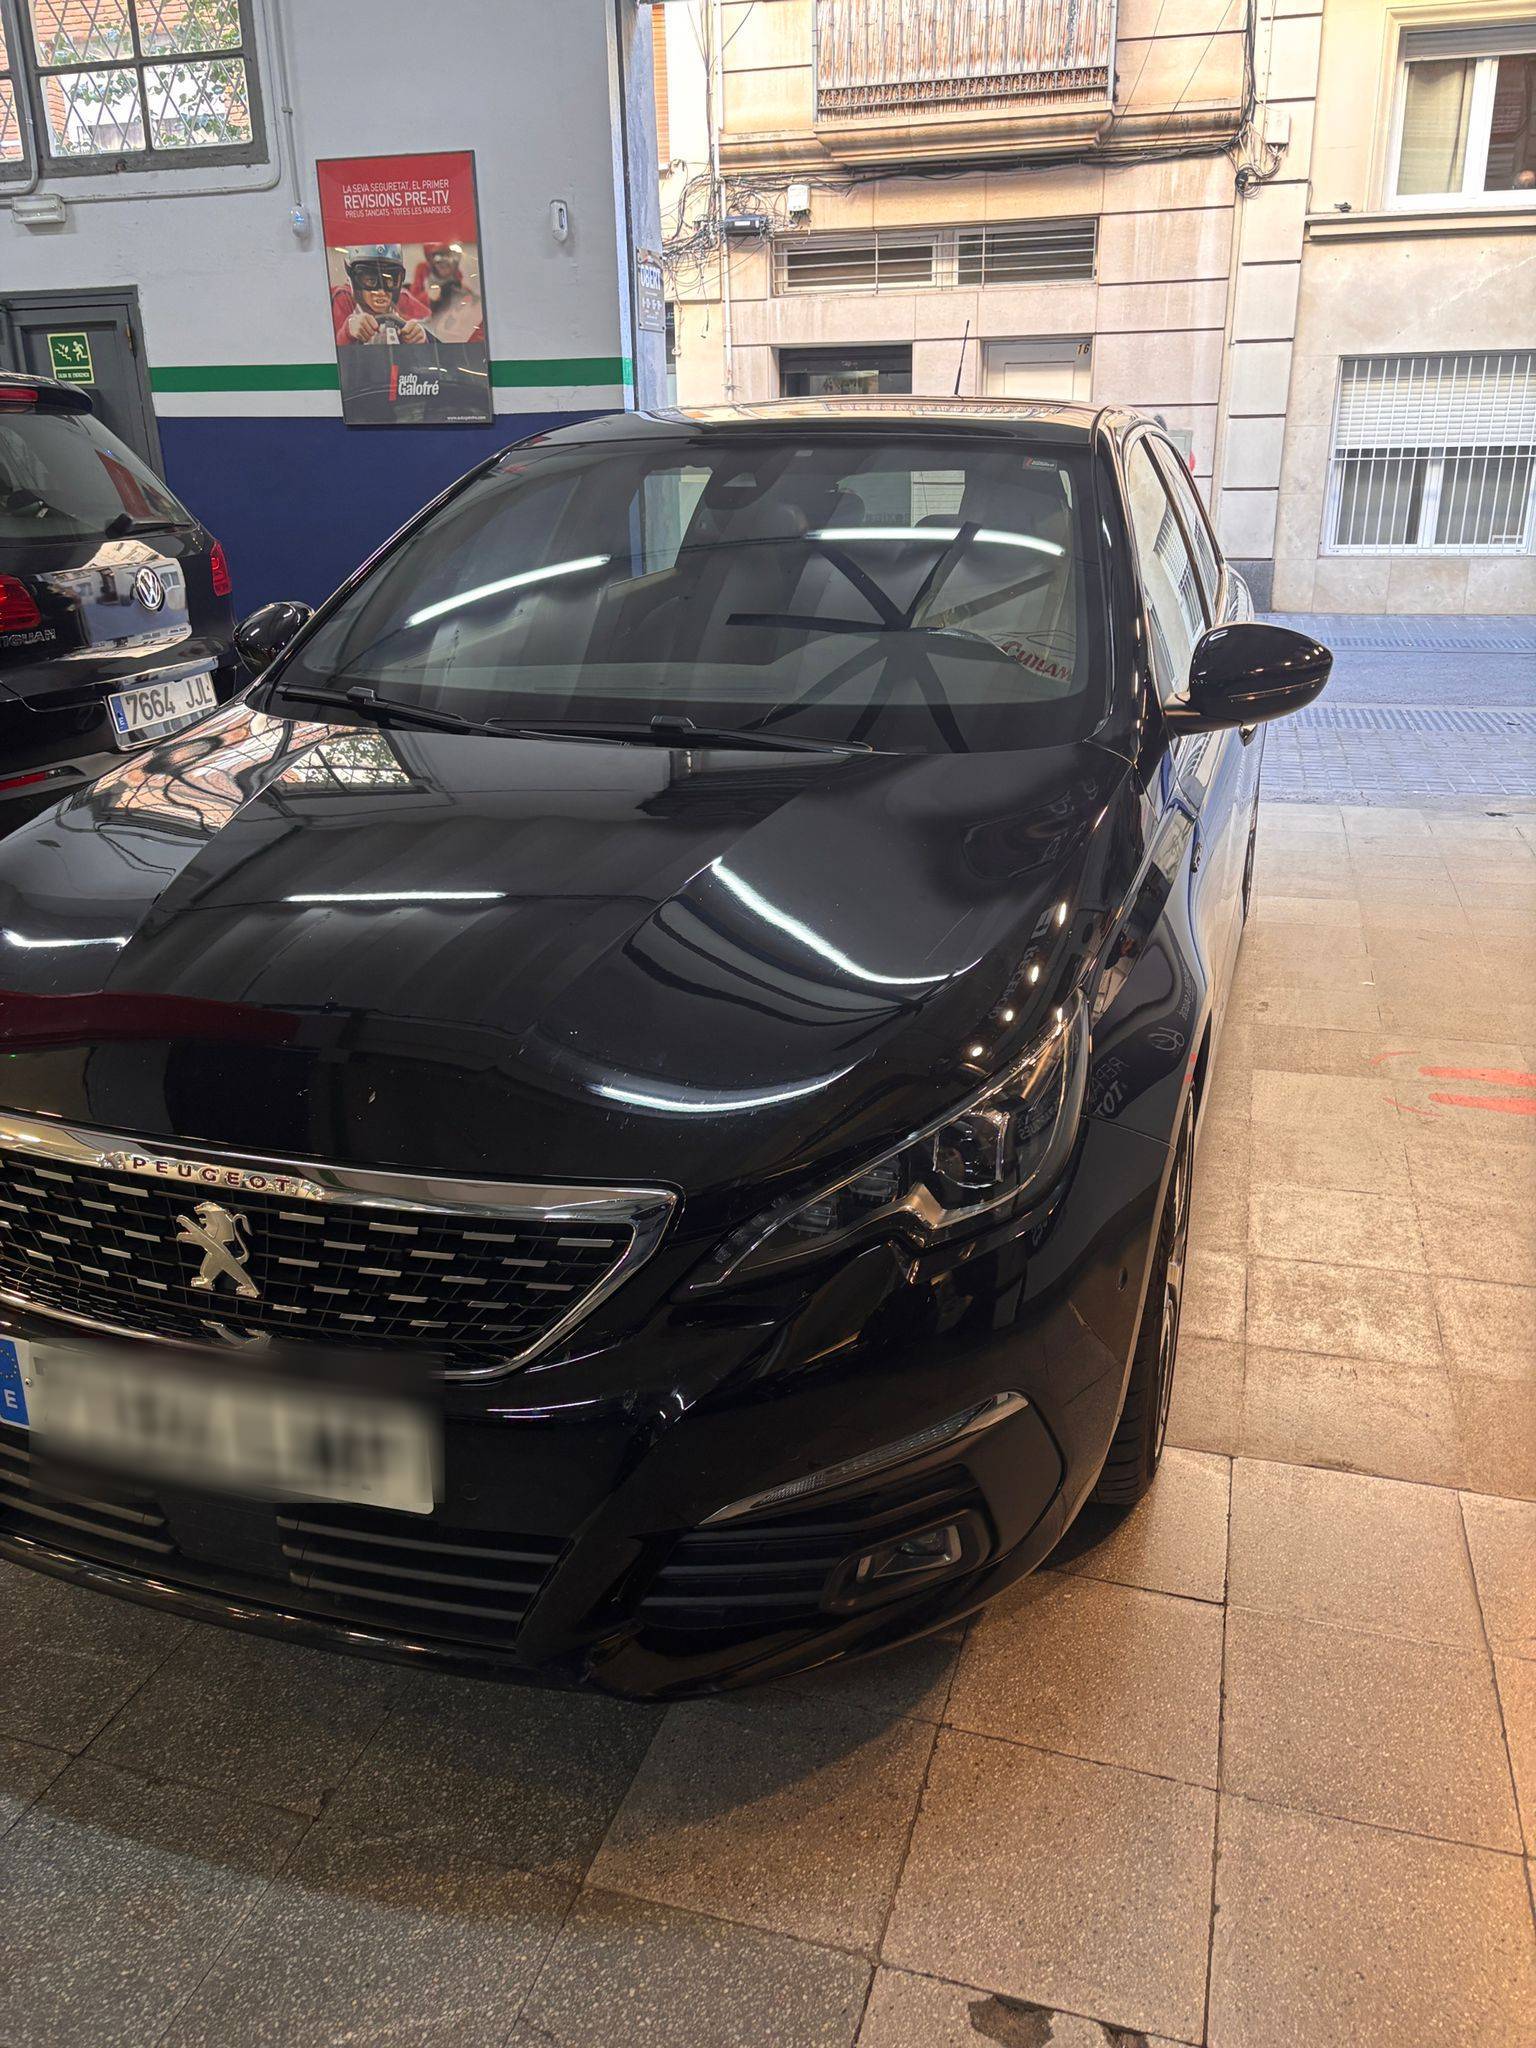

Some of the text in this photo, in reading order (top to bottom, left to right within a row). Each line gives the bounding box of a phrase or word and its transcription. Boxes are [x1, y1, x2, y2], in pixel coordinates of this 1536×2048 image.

[342, 185, 352, 194] LA
[352, 183, 370, 193] SEVA
[412, 180, 420, 190] EL
[422, 179, 449, 189] PRIMER
[344, 190, 449, 209] REVISIONS PRE-ITV
[345, 209, 364, 218] PREUS
[365, 208, 389, 217] TANCATS
[411, 207, 422, 215] LES
[422, 205, 451, 215] MARQUES
[1077, 343, 1090, 355] 16
[399, 373, 418, 384] auto
[398, 380, 440, 396] Galofré
[125, 686, 176, 725] 7664
[185, 677, 213, 708] JJL
[133, 1156, 291, 1192] PEUGEOT
[3, 1388, 18, 1409] E
